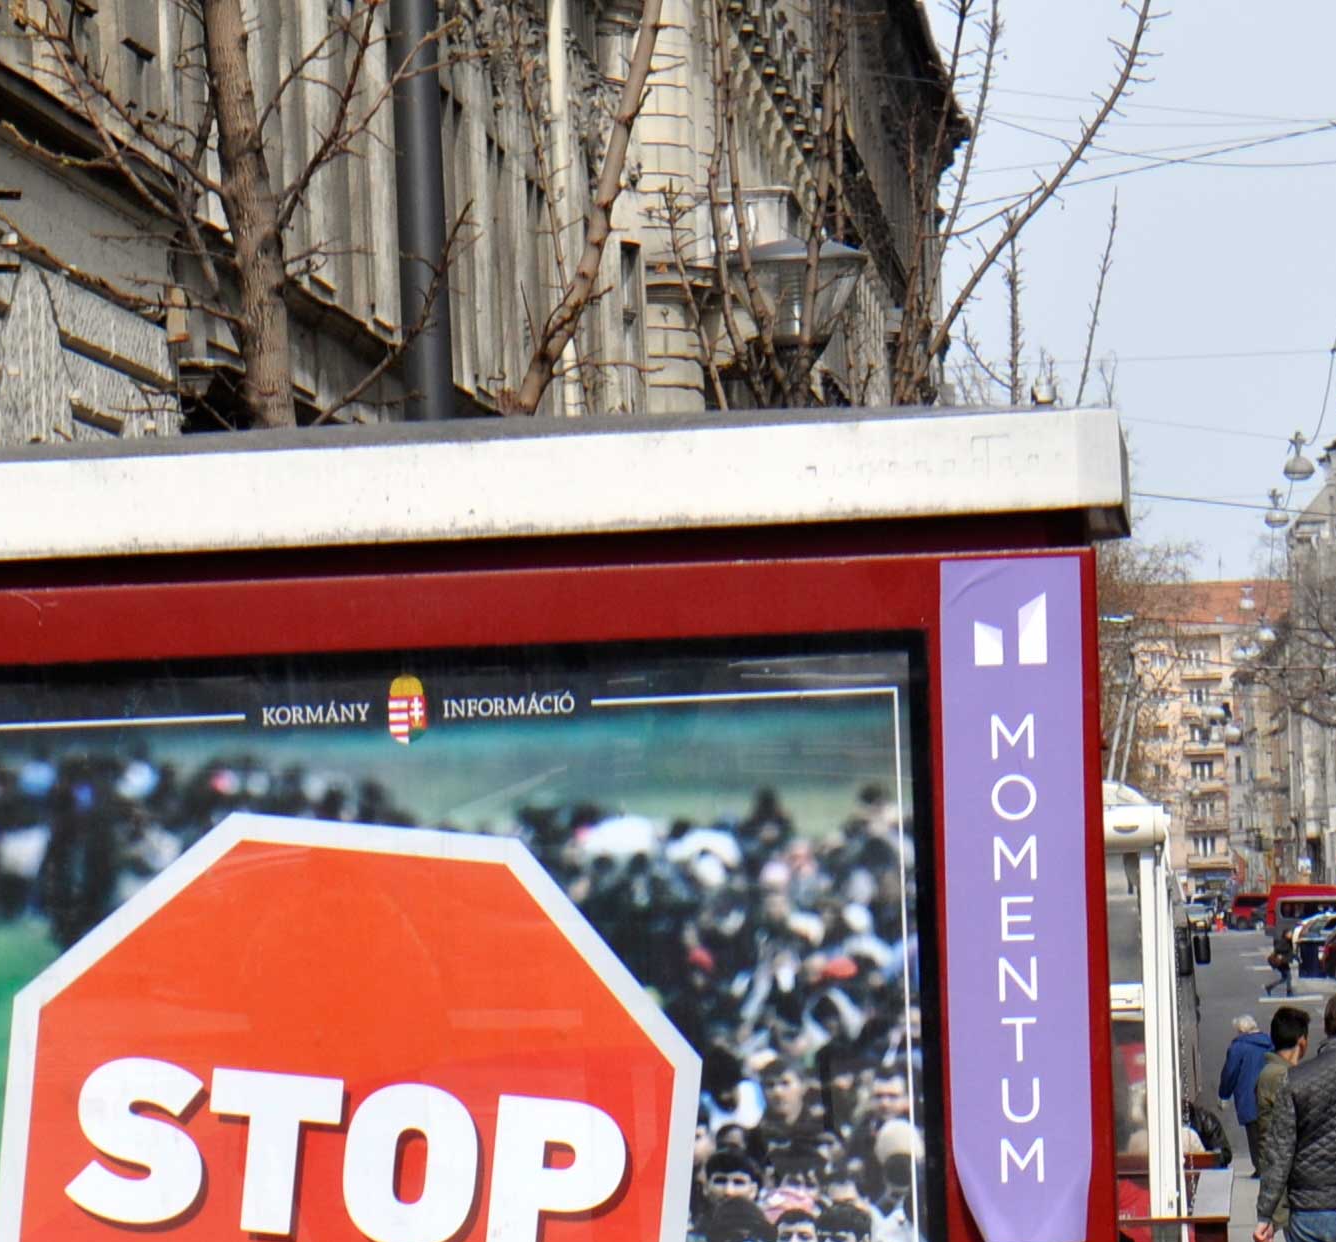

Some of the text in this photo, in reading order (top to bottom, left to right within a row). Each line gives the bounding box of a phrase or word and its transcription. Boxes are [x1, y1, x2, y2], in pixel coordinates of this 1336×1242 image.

[262, 691, 575, 727] KORMÁNY INFORMÁCIÓ
[990, 712, 1045, 1184] MOMENTUM
